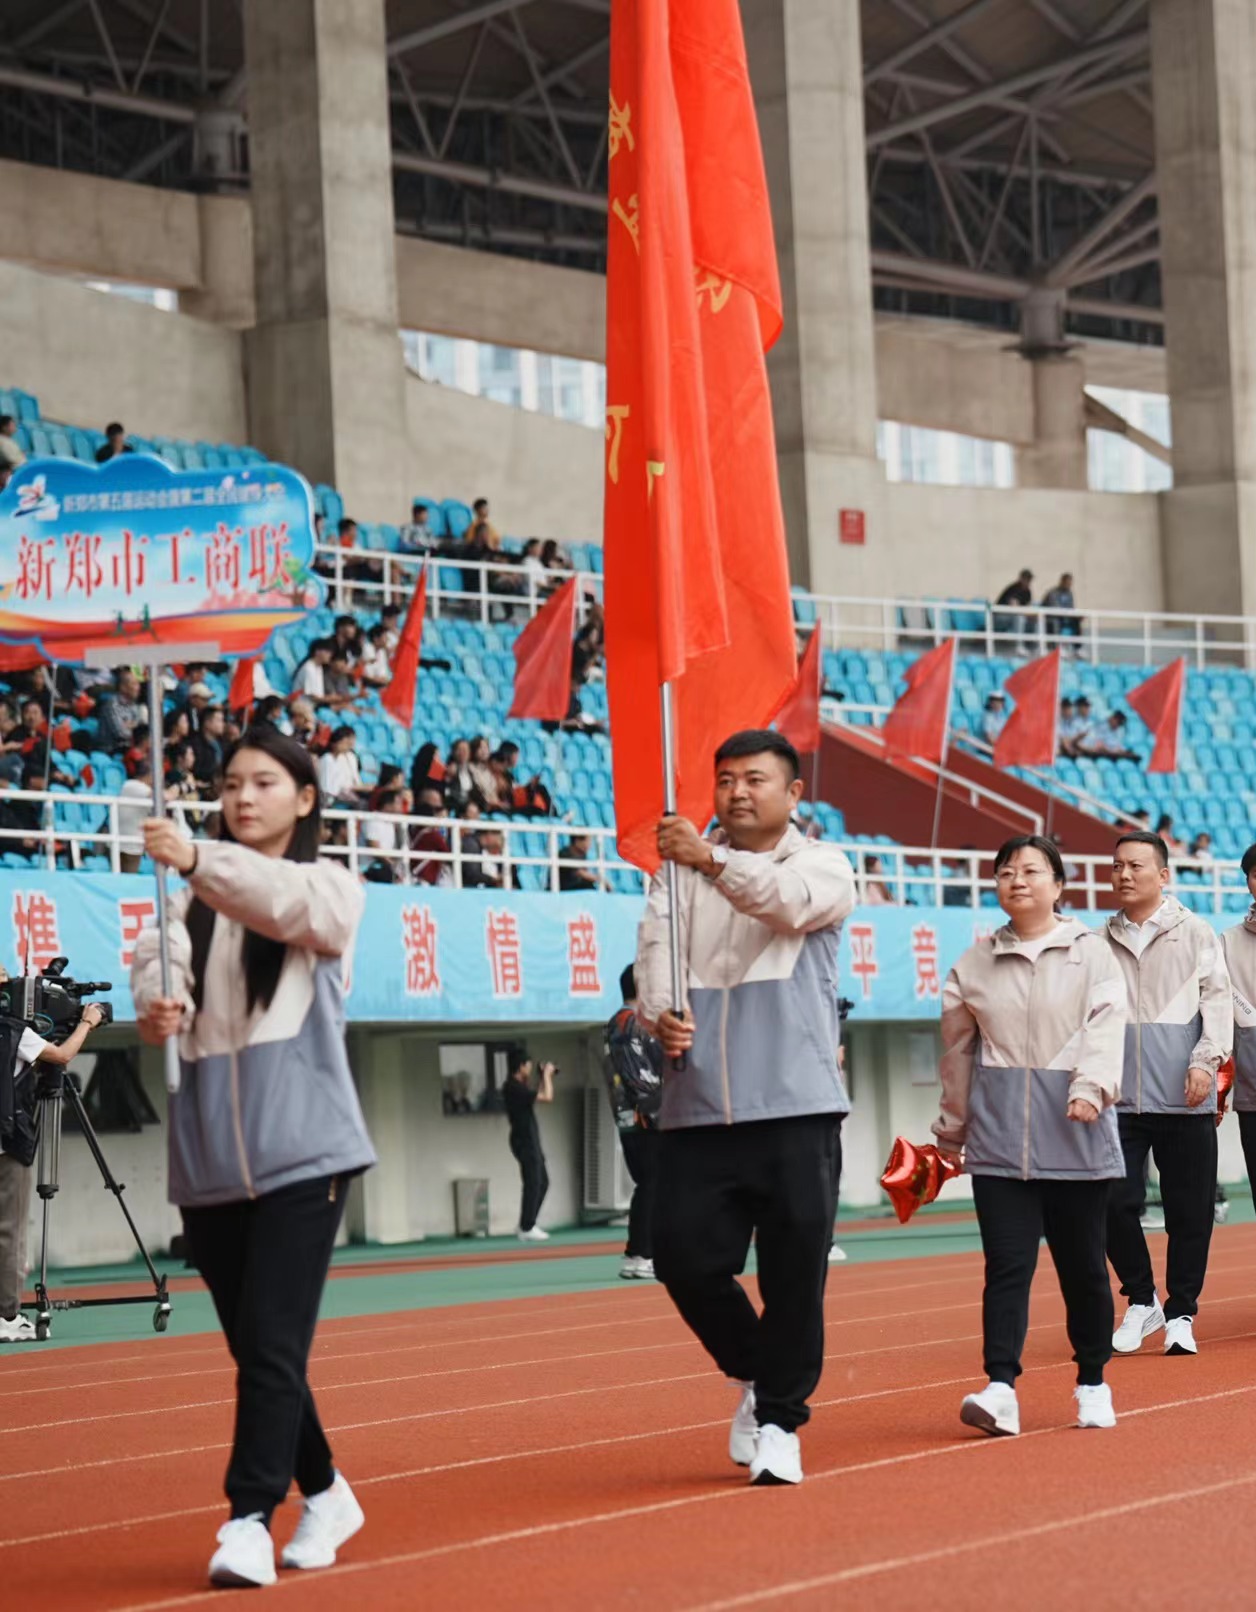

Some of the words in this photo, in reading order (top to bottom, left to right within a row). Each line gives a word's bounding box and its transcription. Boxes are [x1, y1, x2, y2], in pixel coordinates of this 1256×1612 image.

[15, 522, 292, 601] 新郑市工商联
[402, 907, 601, 993] 激情盛
